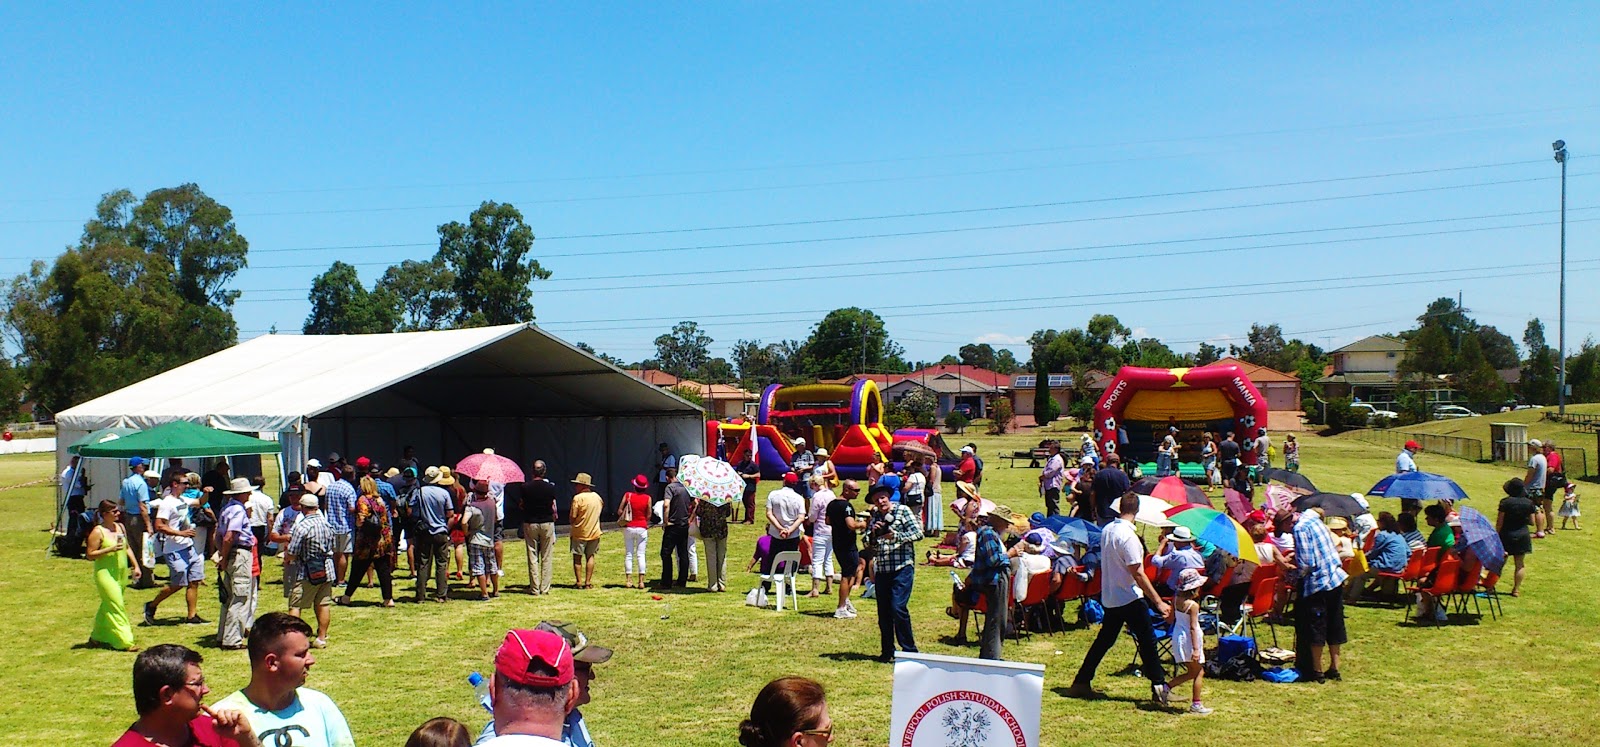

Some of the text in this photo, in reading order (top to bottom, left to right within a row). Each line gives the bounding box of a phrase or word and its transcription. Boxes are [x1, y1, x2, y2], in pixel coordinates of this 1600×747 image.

[1103, 379, 1128, 411] SPORTS
[1232, 376, 1257, 407] MANIA
[926, 693, 958, 711] POLISH
[959, 691, 1005, 714] SATURDAY
